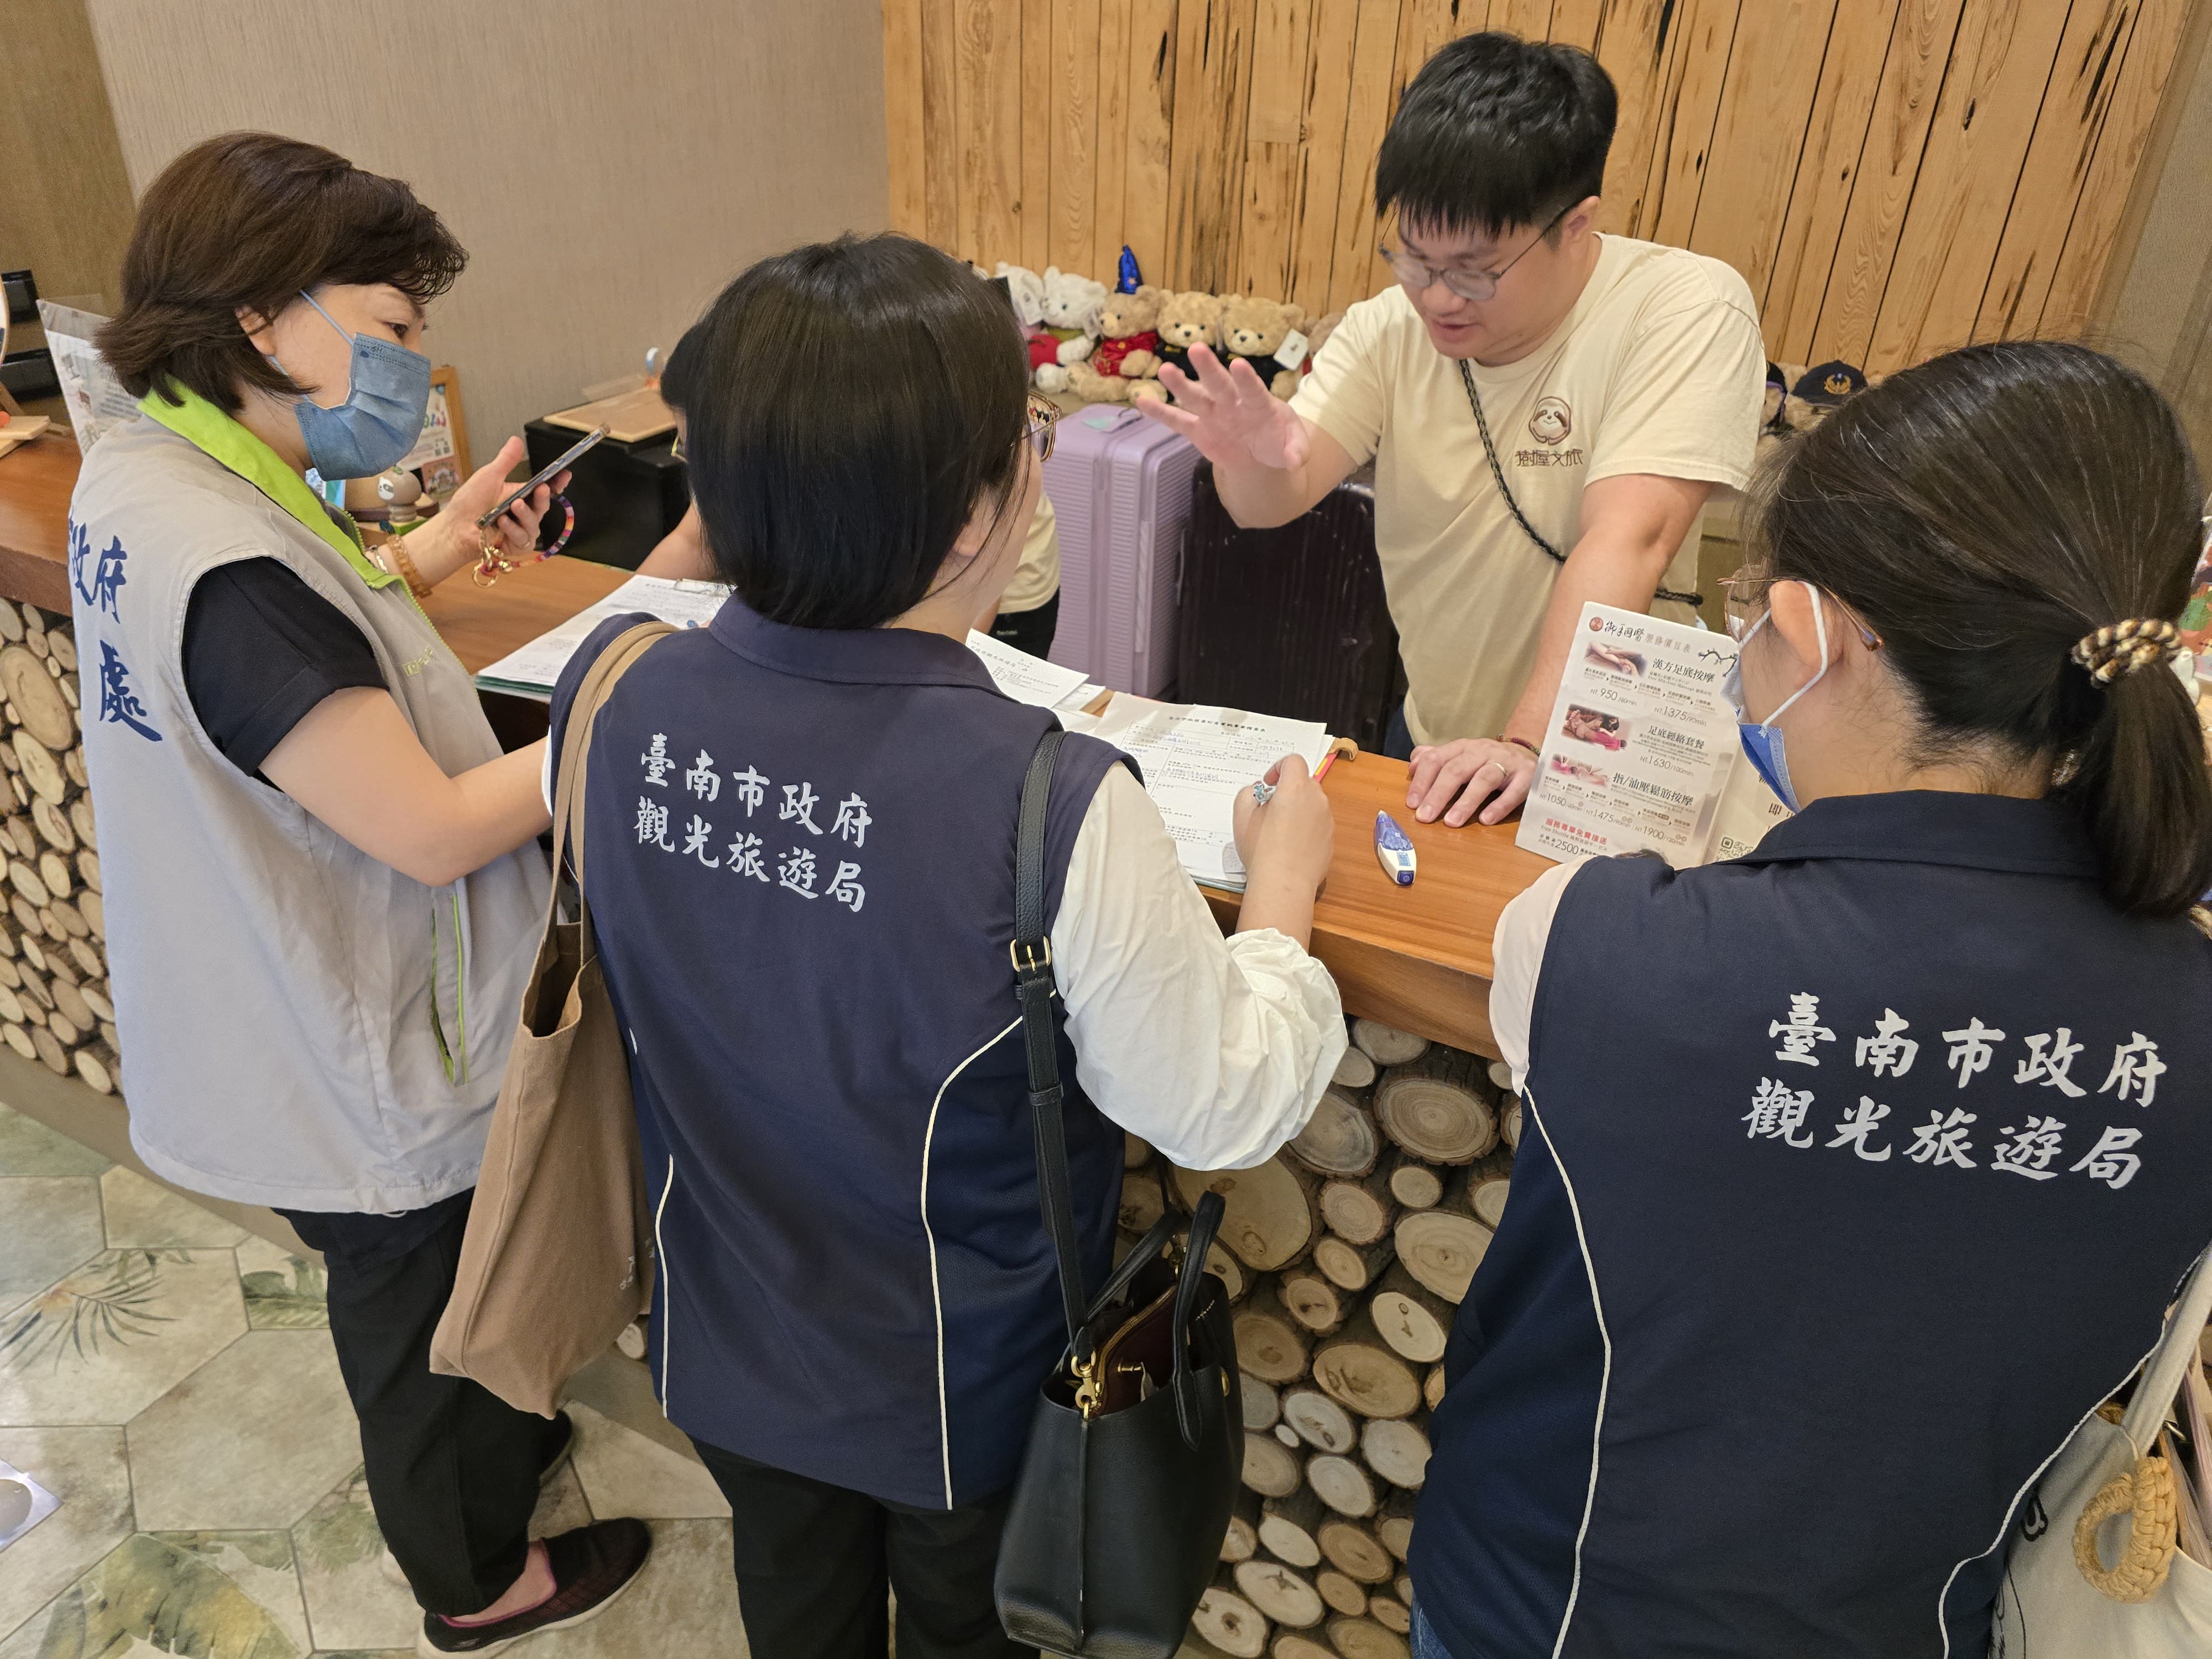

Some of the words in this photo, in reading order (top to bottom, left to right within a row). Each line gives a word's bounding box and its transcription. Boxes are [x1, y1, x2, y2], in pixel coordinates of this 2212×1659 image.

[1652, 658, 1715, 683] 漢方足底按摩
[641, 733, 873, 848] 臺南市政府
[1647, 725, 1705, 749] 足底經絡套餐
[633, 795, 866, 912] 觀光旅遊局
[1555, 839, 1579, 854] 2500
[1768, 992, 2167, 1107] 臺南市政府
[1741, 1077, 2143, 1190] 觀光旅遊局
